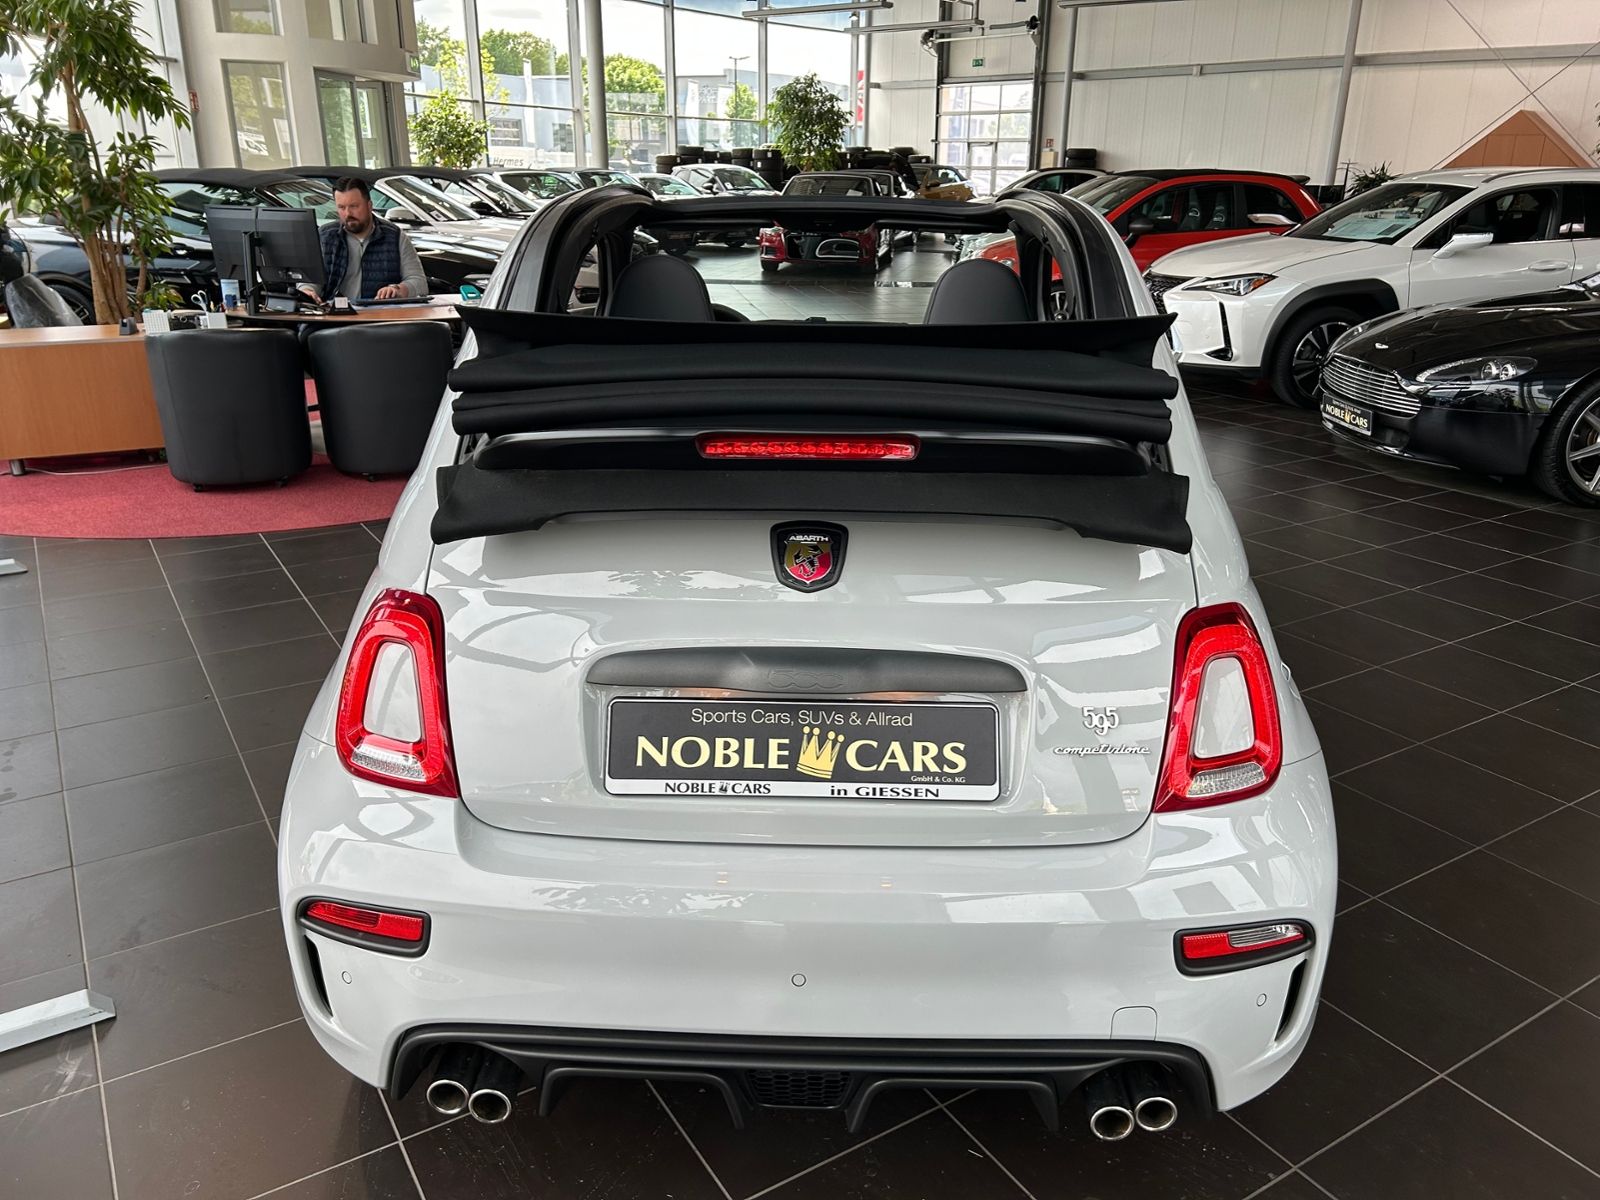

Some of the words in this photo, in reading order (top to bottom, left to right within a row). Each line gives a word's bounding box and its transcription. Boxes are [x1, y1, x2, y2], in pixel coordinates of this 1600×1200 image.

[1326, 404, 1345, 419] NOBLE
[1350, 414, 1368, 428] CARS
[691, 708, 747, 725] Sports
[751, 709, 795, 726] Cars,
[798, 710, 844, 725] SUVs
[849, 712, 862, 726] &
[866, 712, 913, 727] Allrad
[1082, 706, 1119, 735] 595
[636, 736, 790, 769] NOBLE
[845, 739, 967, 774] CARS
[1053, 744, 1151, 757] competizione
[665, 782, 716, 794] NOBLE
[731, 783, 772, 795] CARS
[830, 785, 848, 796] in
[856, 786, 940, 798] GIESSEN
